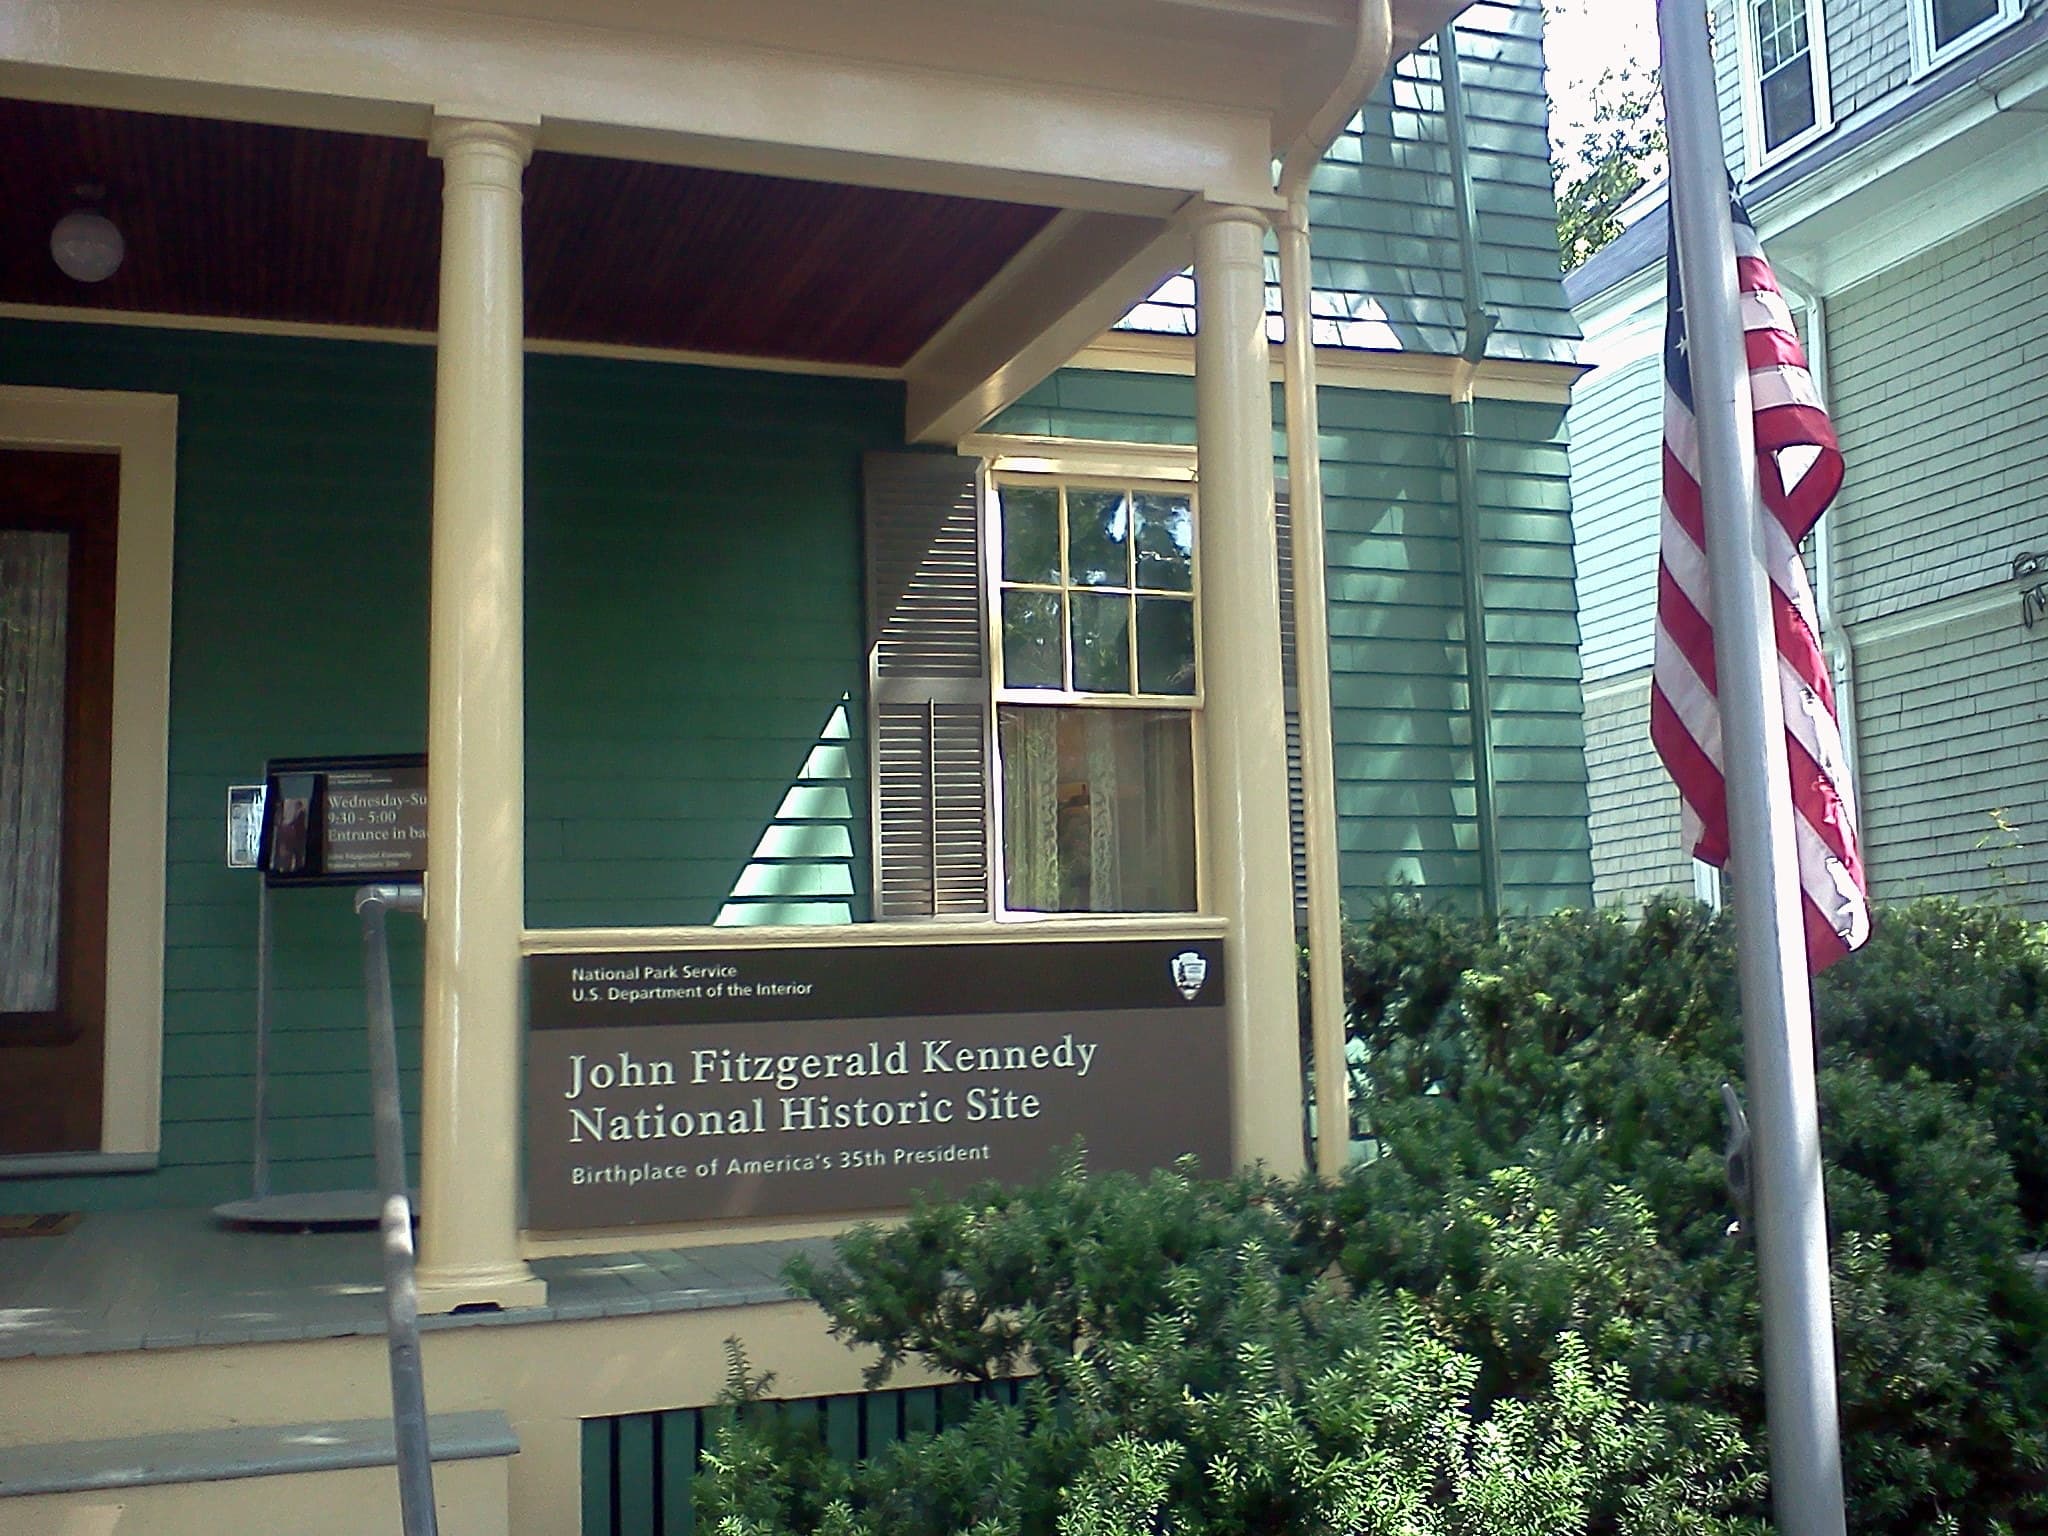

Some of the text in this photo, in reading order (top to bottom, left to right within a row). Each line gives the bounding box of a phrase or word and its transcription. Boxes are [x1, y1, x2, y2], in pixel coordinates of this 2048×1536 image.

[328, 811, 356, 825] 9:30
[368, 811, 397, 824] 5:00
[328, 826, 430, 842] Entrance in ba
[571, 963, 738, 983] National Park Service
[571, 980, 814, 1004] U.S. Department of the Interior
[564, 1033, 1098, 1099] John Fitzgerald Kennedy
[567, 1087, 1041, 1143] National Historic Site
[571, 1144, 990, 1187] Birthplace of America's 35th President
